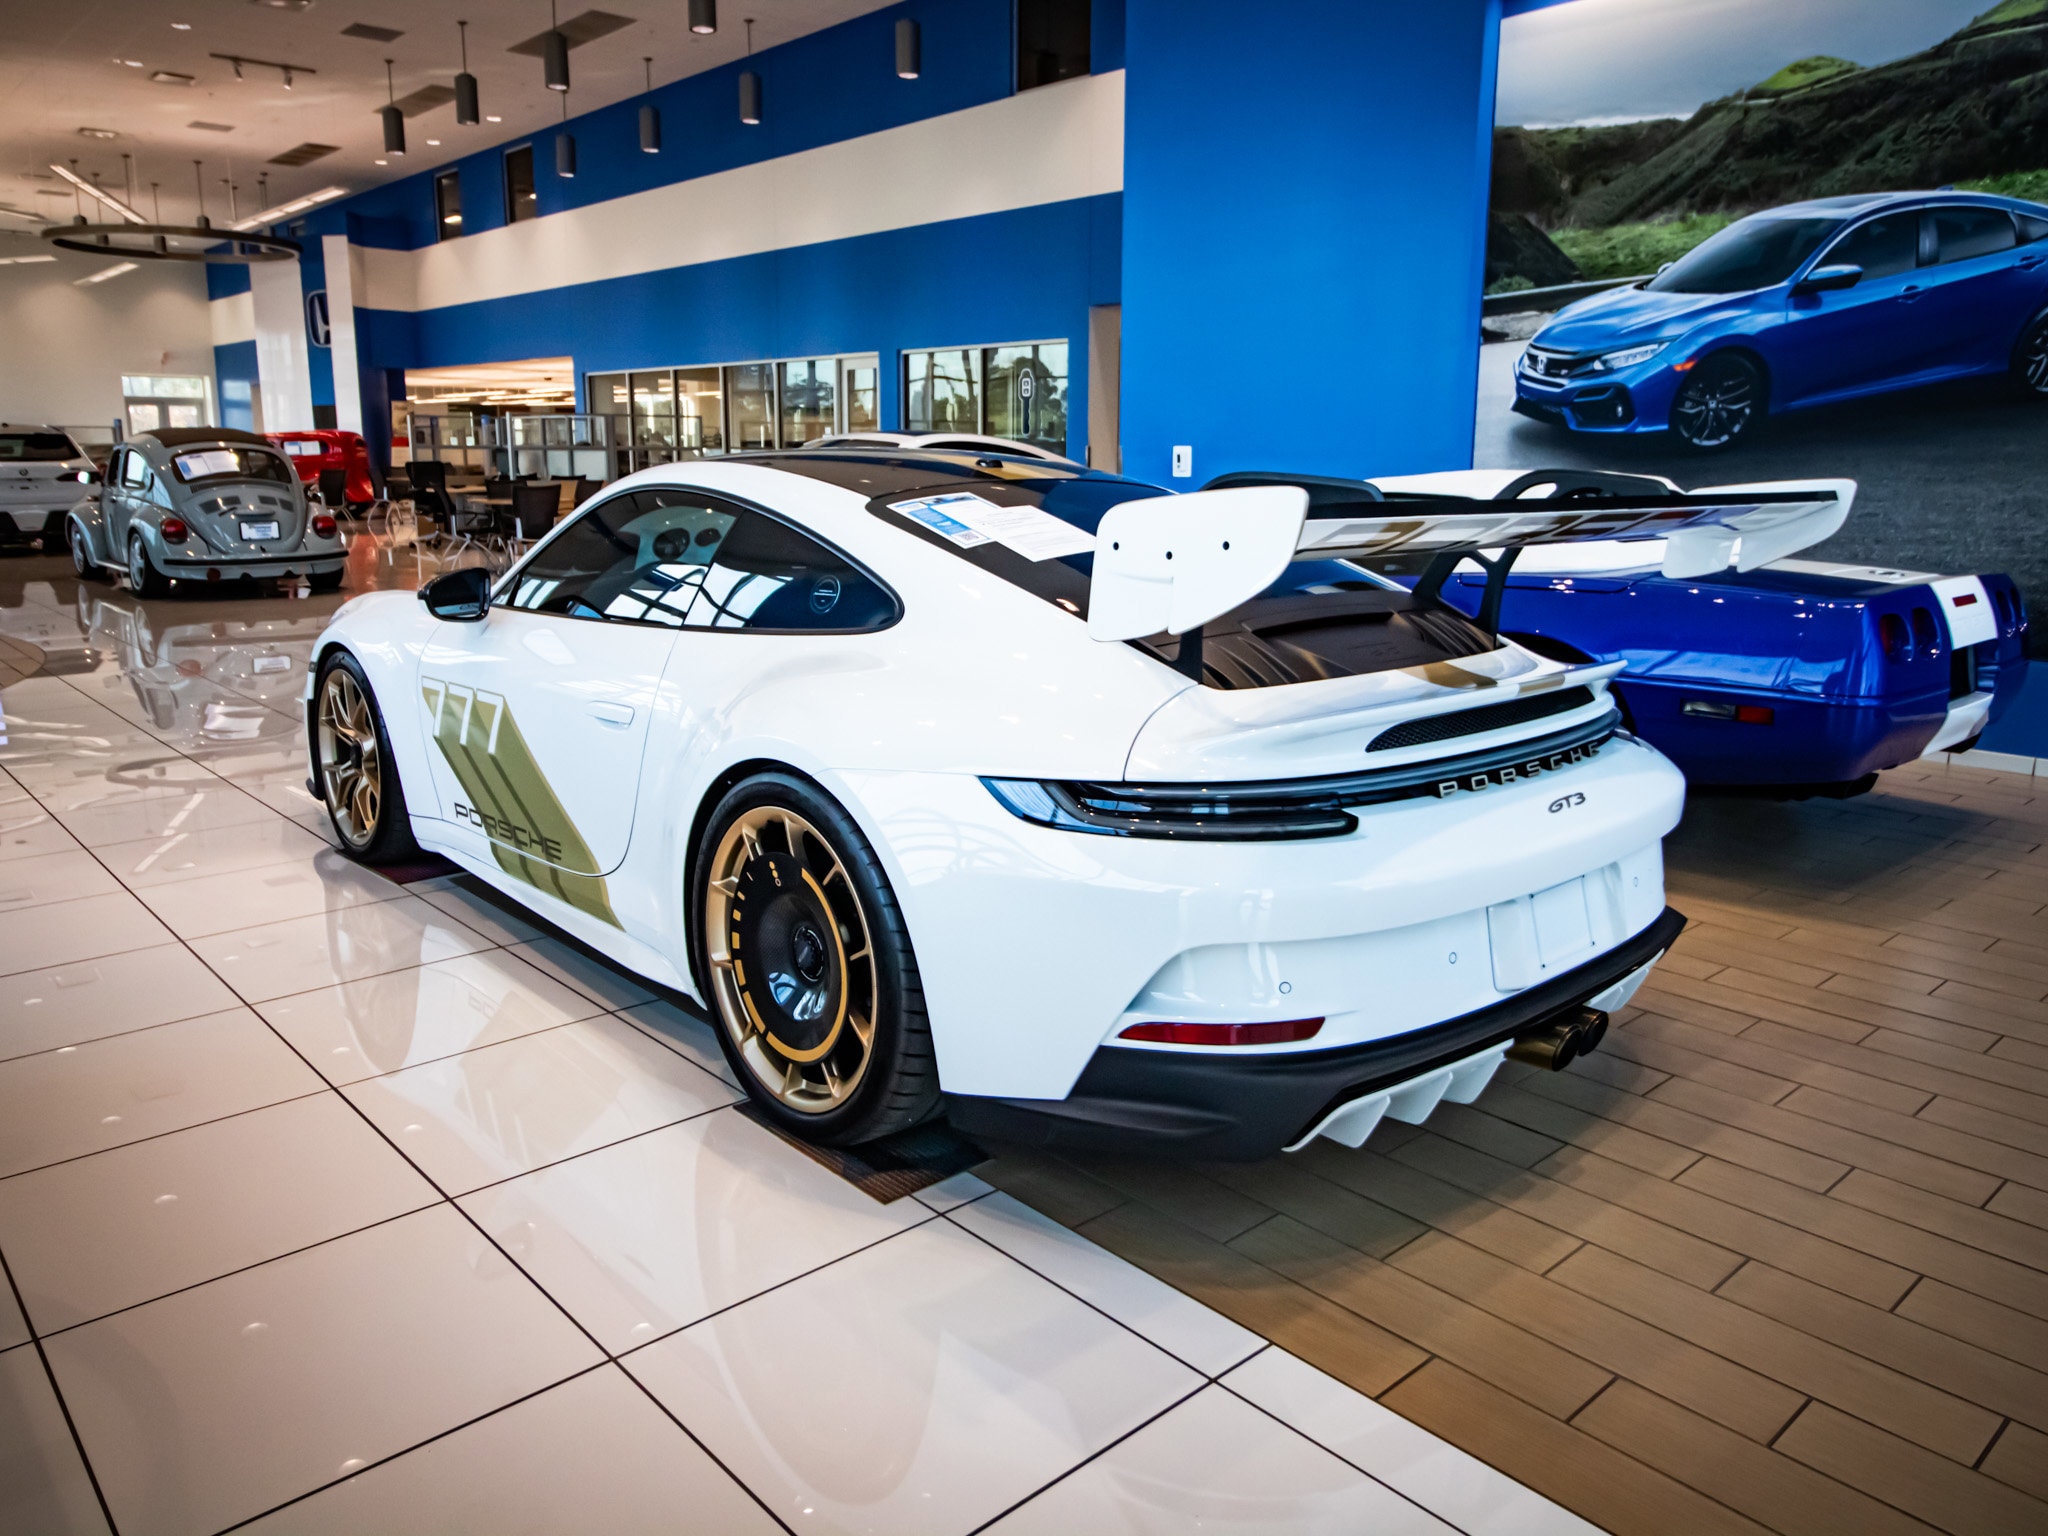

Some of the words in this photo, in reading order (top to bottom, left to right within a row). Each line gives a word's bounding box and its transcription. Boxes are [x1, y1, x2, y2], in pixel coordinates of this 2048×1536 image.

[422, 676, 505, 755] 777
[1439, 742, 1600, 798] PORSCHE
[455, 803, 561, 860] PORSCHE
[1548, 792, 1586, 815] GT3
